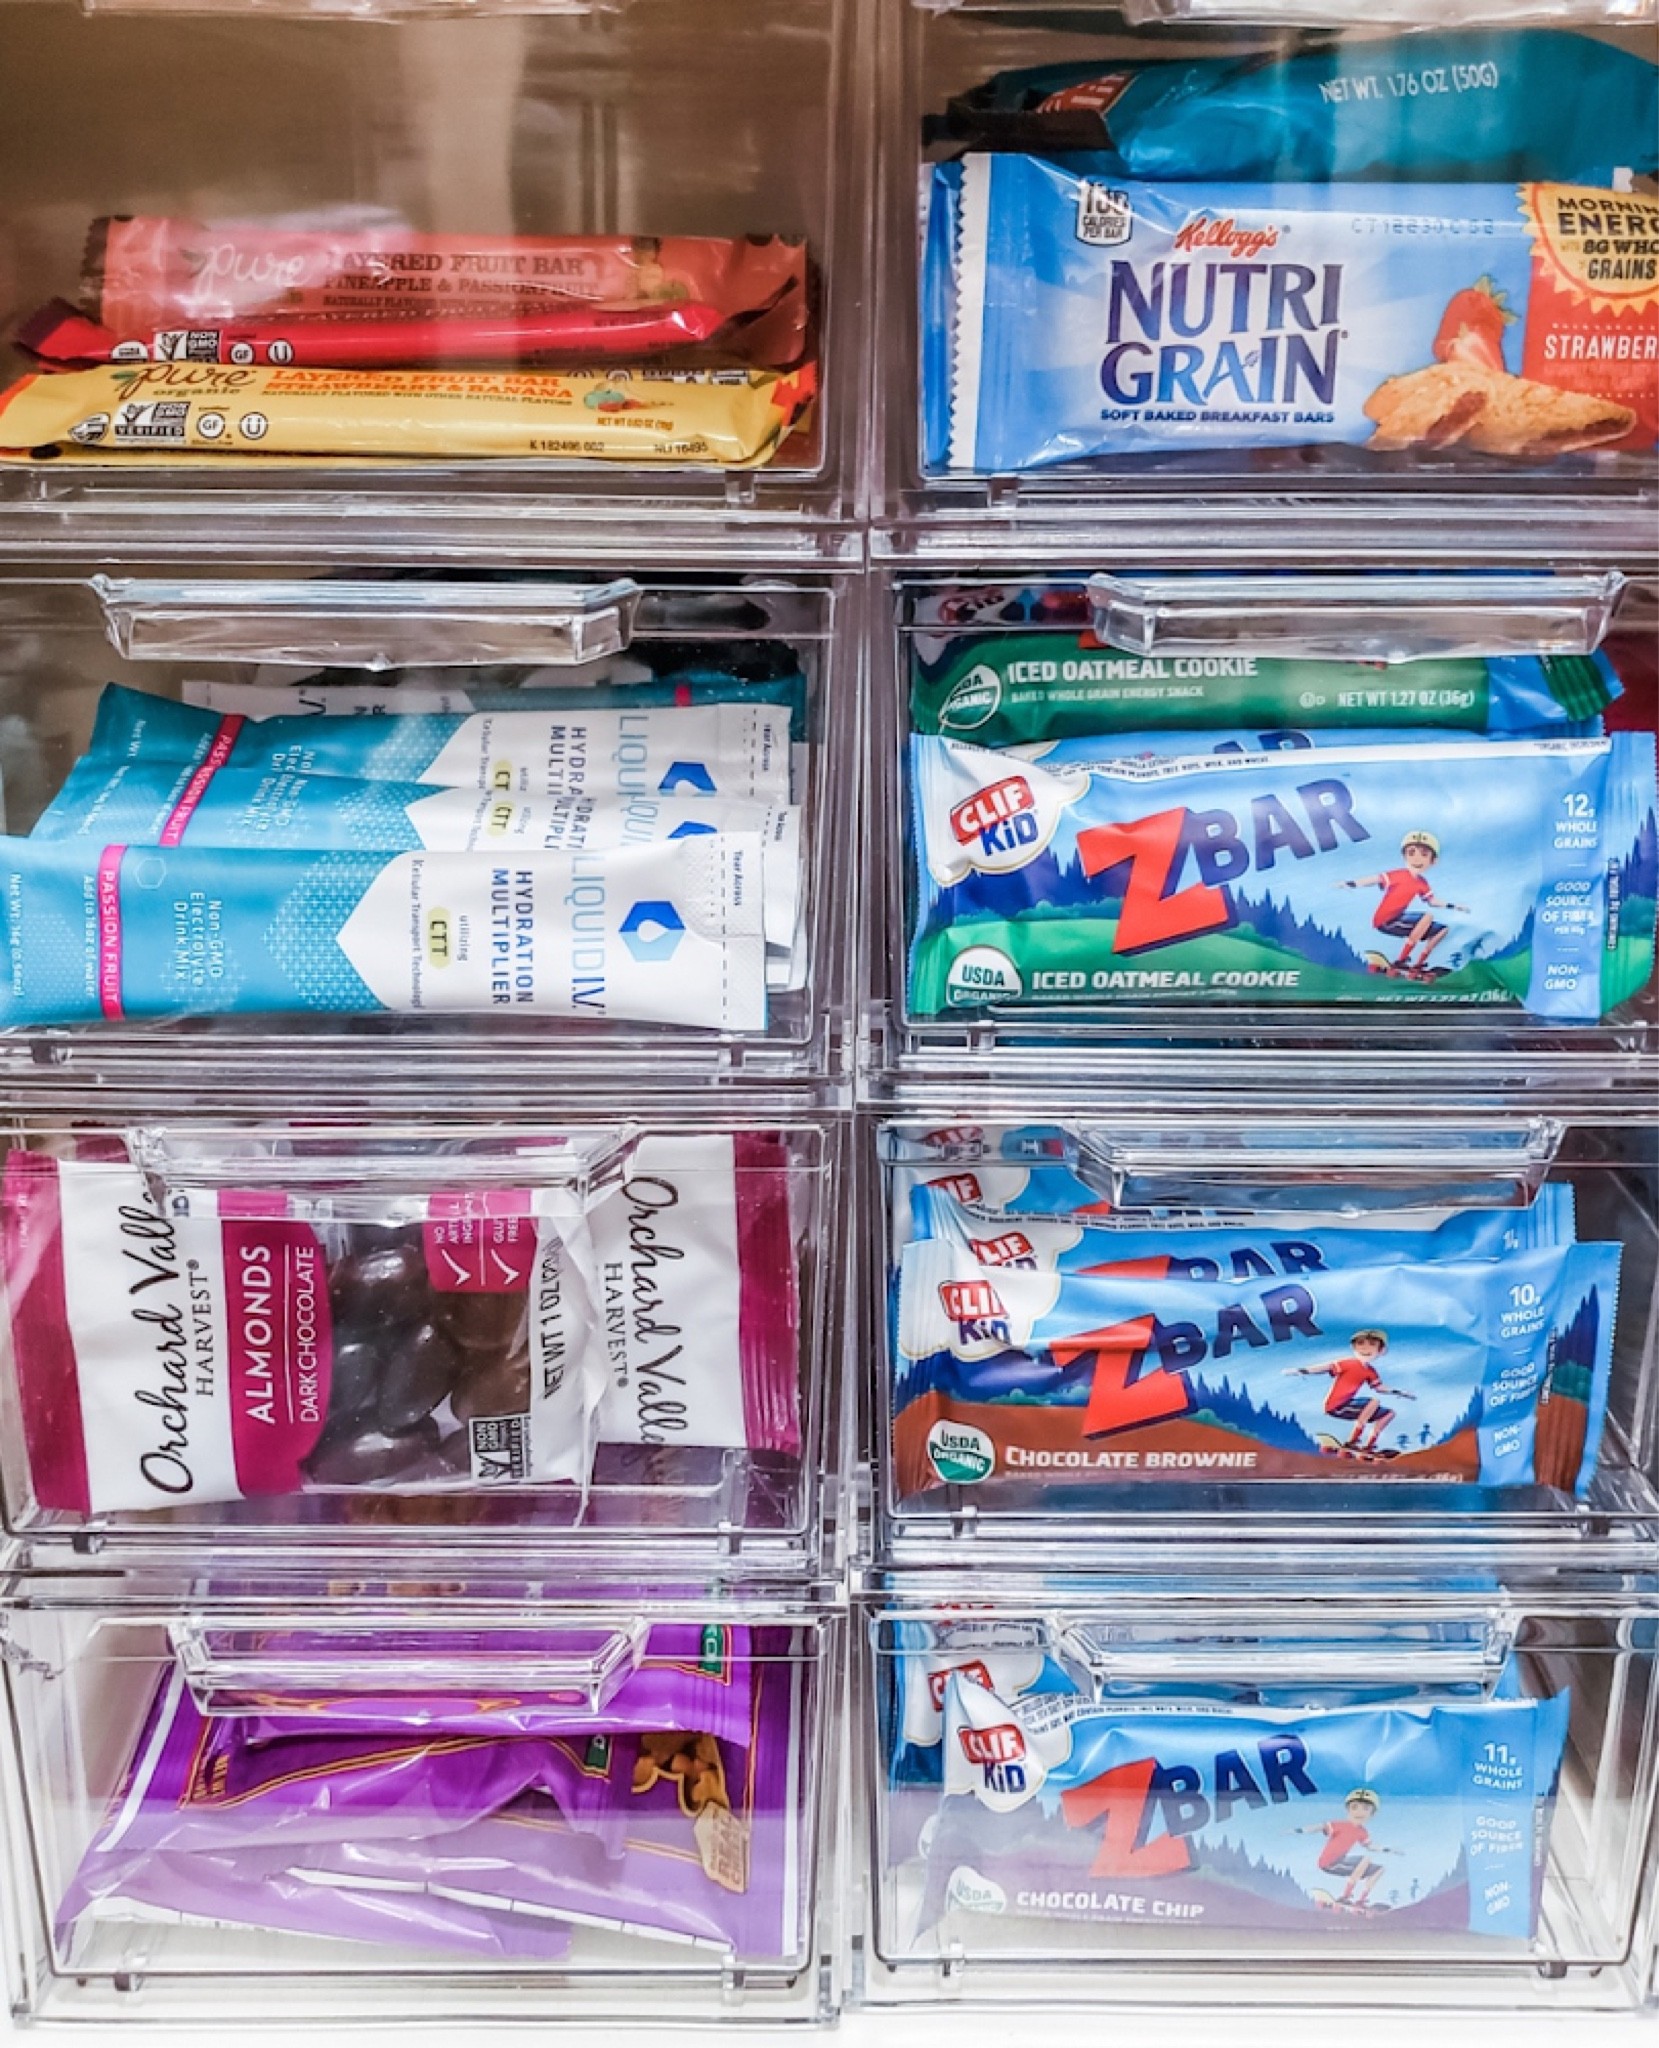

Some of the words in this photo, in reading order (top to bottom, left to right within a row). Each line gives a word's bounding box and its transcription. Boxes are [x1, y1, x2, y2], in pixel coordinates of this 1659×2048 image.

[1318, 77, 1349, 104] NET
[1421, 69, 1449, 94] OZ
[1452, 61, 1498, 93] (50G)
[1083, 215, 1126, 227] CALORIES
[1083, 226, 1102, 238] PER
[1104, 227, 1123, 239] BAR
[1174, 217, 1280, 258] Kellogg's
[449, 253, 527, 273] FRUIT
[532, 257, 585, 275] BAR
[1588, 258, 1658, 281] GRAINS
[324, 276, 432, 293] PINEAPPLE
[437, 278, 452, 293] &
[1105, 259, 1343, 344] NUTRI
[272, 369, 402, 384] LAYERED
[411, 373, 497, 385] FRUIT
[503, 374, 561, 388] BAR
[1100, 329, 1340, 406] GRAIN
[119, 363, 251, 401] pure
[153, 386, 242, 398] organic
[264, 381, 444, 392] STRAWBERRY
[447, 383, 465, 393] &
[465, 384, 574, 398] BANANA
[202, 419, 220, 431] GF
[246, 417, 263, 435] U
[1101, 409, 1140, 421] SOFT
[1144, 410, 1197, 421] BAKED
[1200, 411, 1290, 423] BREAKFAST
[1294, 412, 1335, 423] BARS
[115, 425, 185, 437] VERIFIED
[530, 440, 538, 450] K
[1007, 661, 1057, 685] ICED
[1062, 659, 1171, 683] OATMEAL
[1173, 657, 1259, 679] COOKIE
[1011, 690, 1045, 703] BAKED
[1047, 690, 1084, 702] WHOLE
[1086, 688, 1121, 701] GRAIN
[1122, 687, 1165, 700] ENERGY
[1166, 686, 1205, 698] SNACK
[1337, 691, 1365, 708] NET
[1366, 691, 1388, 708] WT
[1389, 690, 1416, 708] 1.27
[1418, 690, 1437, 707] OZ
[957, 783, 1032, 834] CLIF
[733, 850, 745, 871] Tear
[9, 873, 22, 897] Net
[83, 876, 96, 900] Add
[733, 873, 744, 907] Across
[1554, 881, 1592, 892] GOOD
[84, 901, 95, 915] to
[102, 870, 119, 948] PASSION
[1545, 894, 1592, 907] SOURCE
[173, 901, 190, 944] Drink
[563, 856, 606, 971] LIQUID
[1541, 910, 1559, 923] OF
[189, 892, 206, 986] Electrolyte
[208, 900, 225, 978] Non-GMO
[409, 903, 423, 952] Transport
[430, 919, 448, 958] CTT
[456, 914, 471, 962] utilizing
[491, 867, 511, 1005] MULTIPLIER
[515, 870, 534, 1003] HYDRATION
[84, 945, 96, 959] of
[174, 949, 189, 980] Mix
[961, 964, 1006, 986] USDA
[83, 960, 96, 999] water
[103, 953, 119, 1003] FRUIT
[1031, 970, 1086, 989] ICED
[1091, 970, 1207, 989] OATMEAL
[1211, 969, 1301, 988] COOKIE
[1543, 978, 1577, 990] GMO
[622, 1175, 686, 1344] Orchard
[539, 1282, 562, 1311] OZ
[295, 1245, 319, 1372] CHOCOLATE
[602, 1260, 629, 1378] HARVEST
[1500, 1306, 1545, 1324] WHOLE
[540, 1315, 561, 1326] 1
[188, 1270, 215, 1397] HARVEST
[240, 1244, 276, 1425] ALMONDS
[540, 1330, 566, 1364] WT
[1500, 1361, 1535, 1379] GOOD
[132, 1303, 194, 1494] Orchard
[299, 1373, 319, 1422] DARK
[634, 1344, 691, 1445] Valle
[1489, 1392, 1507, 1407] OF
[938, 1429, 981, 1451] USDA
[1493, 1439, 1521, 1457] GMO
[932, 1447, 986, 1474] ORGANIC
[1004, 1445, 1139, 1469] CHOCOLATE
[1145, 1451, 1258, 1468] BROWNIE
[1473, 1761, 1524, 1778] WHOLE
[1472, 1774, 1524, 1791] GRAINS
[1475, 1815, 1517, 1830] GOOD
[1470, 1829, 1522, 1842] SOURCE
[1469, 1844, 1484, 1857] OF
[956, 1878, 992, 1901] USDA
[1016, 1890, 1147, 1915] CHOCOLATE
[1152, 1899, 1206, 1920] CHIP
[1485, 1896, 1511, 1916] GMO
